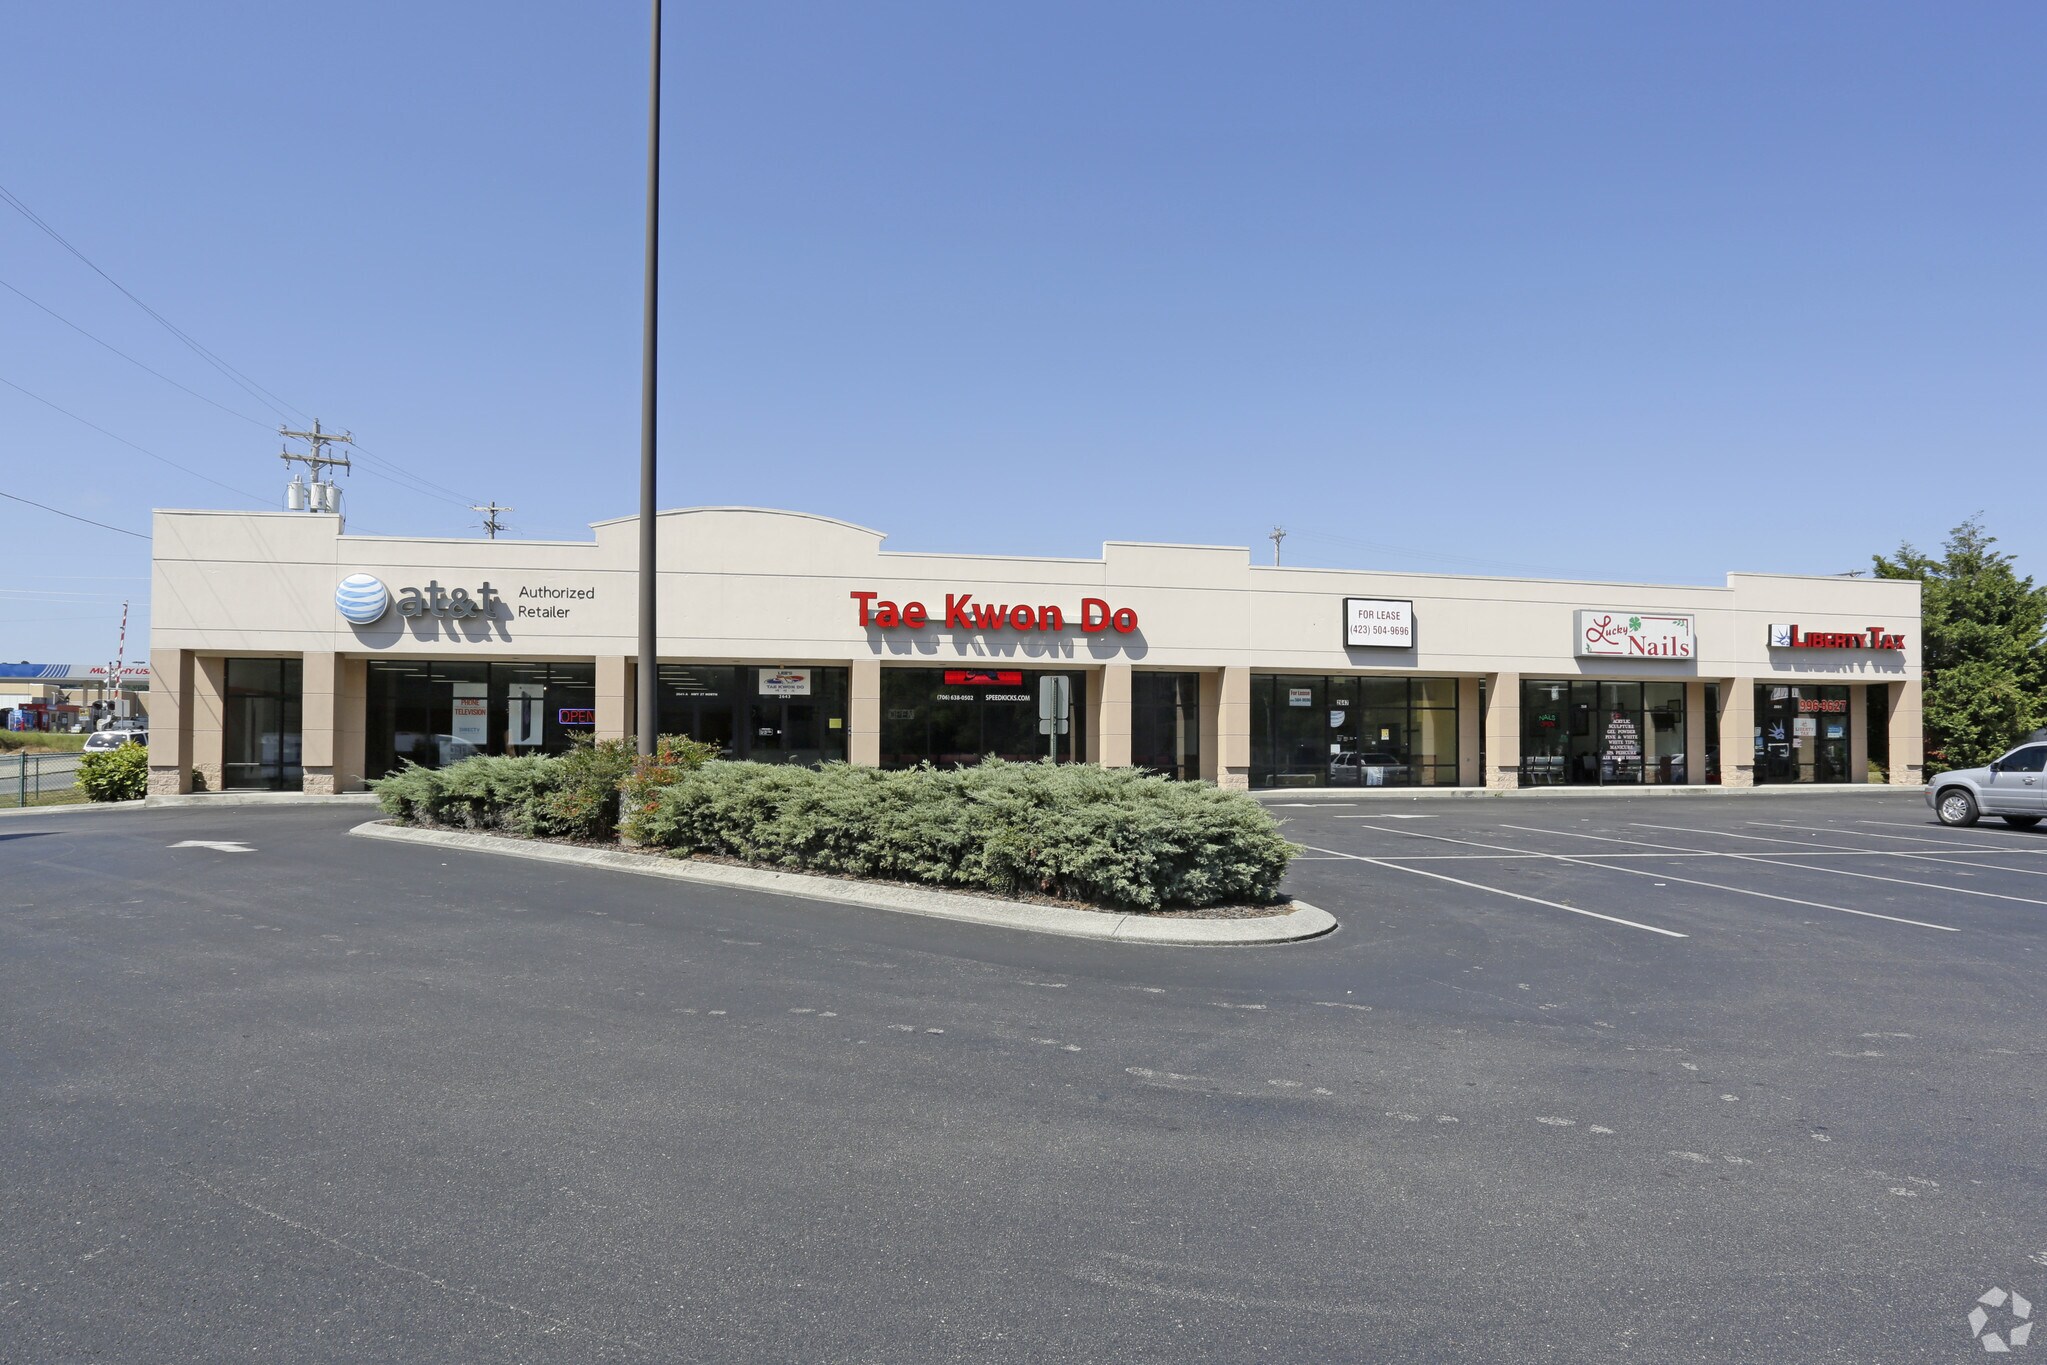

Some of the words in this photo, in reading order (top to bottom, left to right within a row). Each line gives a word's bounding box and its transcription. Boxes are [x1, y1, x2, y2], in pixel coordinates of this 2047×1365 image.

[518, 586, 595, 600] Authorized
[518, 605, 570, 619] Retailer
[850, 591, 928, 629] Tae
[945, 593, 1063, 632] Kwon
[1081, 597, 1138, 634] Do
[1358, 609, 1374, 620] FOR
[1376, 610, 1401, 621] LEASE
[1350, 624, 1371, 636] (423)
[1372, 625, 1409, 636] 504-9696
[1585, 615, 1628, 645] Lucky
[1790, 624, 1868, 649] LIBERTY
[1866, 627, 1906, 650] TAX
[1628, 635, 1690, 657] Nails
[985, 694, 1031, 702] SPEEDKICKS.COM
[455, 708, 486, 716] TELEVISION
[561, 710, 595, 722] OPEN
